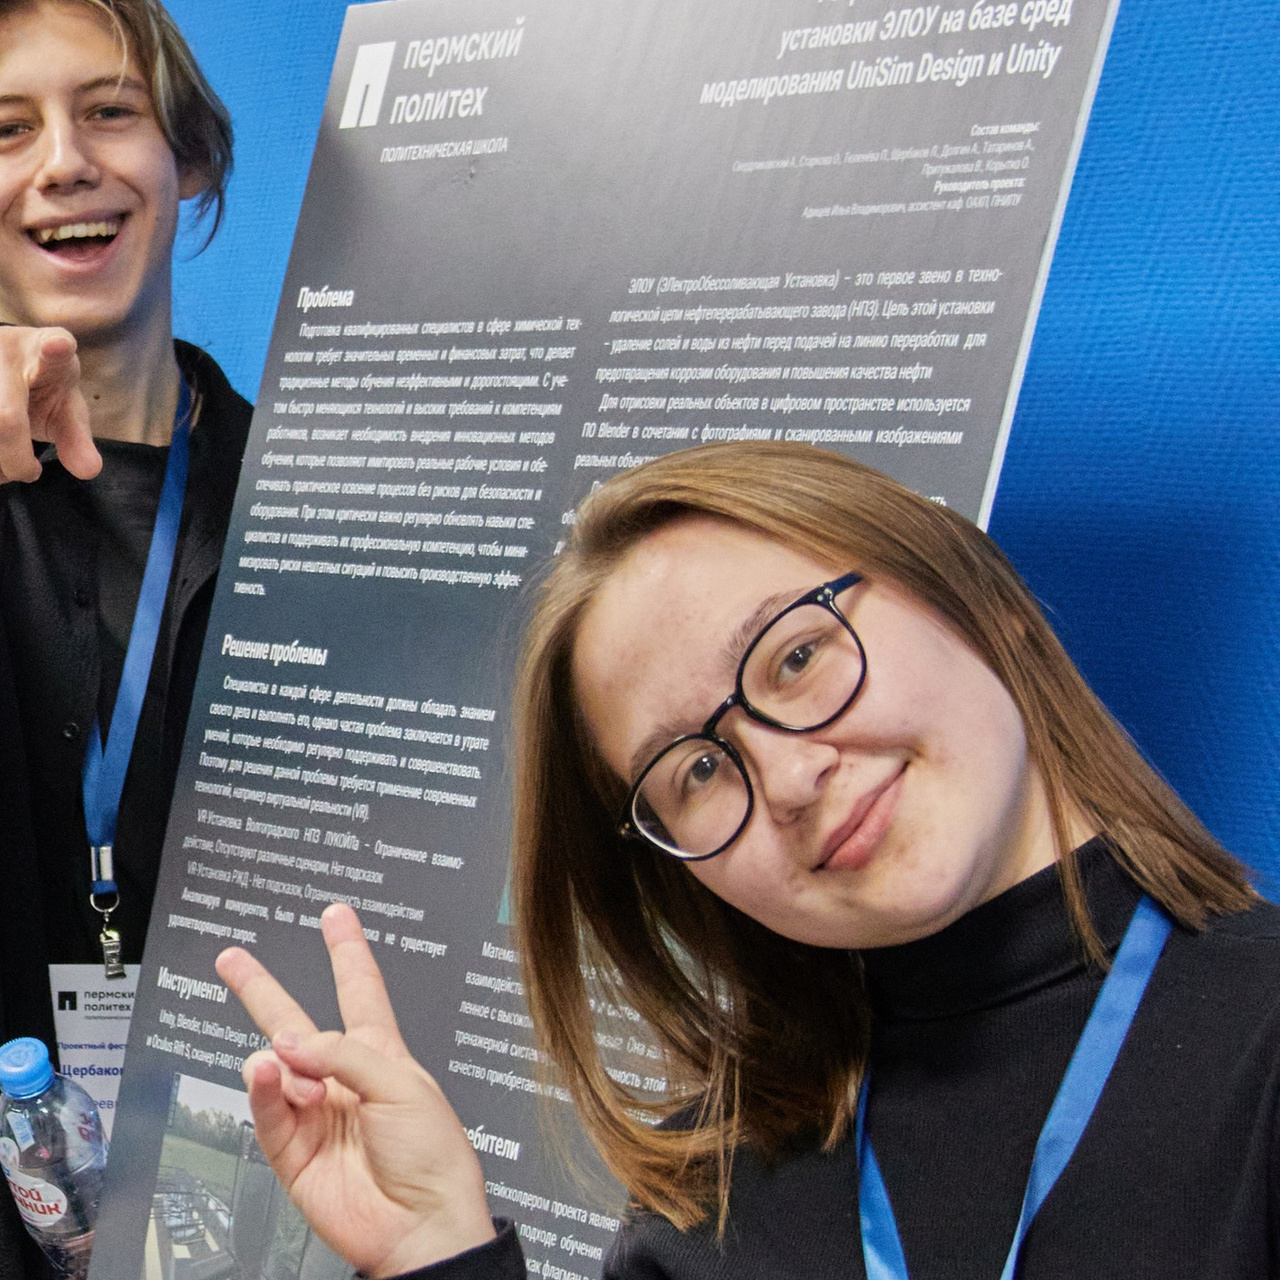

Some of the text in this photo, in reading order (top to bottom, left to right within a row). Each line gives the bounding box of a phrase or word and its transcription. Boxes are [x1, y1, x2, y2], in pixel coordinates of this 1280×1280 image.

[776, 20, 878, 59] установки
[879, 4, 940, 40] ЭЛОУ
[938, 8, 965, 34] на
[403, 16, 524, 78] пермский
[699, 39, 1062, 107] моделирования UniSim Design и Unity
[389, 86, 488, 124] политех
[379, 137, 508, 163] ПОЛИТЕХНИЧЕСКАЯ ШКОЛА
[628, 277, 656, 294] ЭЛОУ
[656, 274, 781, 296] (ЭЛектроОбессоливающая
[783, 269, 840, 290] Установка)
[854, 272, 874, 286] это
[876, 271, 916, 289] первое
[918, 270, 952, 284] звено
[968, 268, 1003, 282] техно-
[296, 284, 355, 313] Проблема
[608, 306, 661, 323] логической
[659, 308, 684, 324] цепи
[683, 303, 810, 324] нефтеперерабатывающего
[810, 304, 847, 320] завода
[881, 299, 909, 319] Цель
[910, 298, 937, 316] этой
[935, 300, 996, 319] установки
[609, 338, 653, 355] удаление
[653, 334, 682, 351] солей
[690, 337, 717, 353] воды
[716, 337, 731, 350] из
[730, 333, 762, 353] нефти
[762, 336, 793, 352] перед
[793, 332, 837, 351] подачей
[837, 335, 852, 348] на
[852, 334, 889, 348] линию
[889, 329, 960, 351] переработки
[962, 333, 987, 350] для
[594, 367, 670, 384] предотвращения
[669, 367, 714, 383] коррозии
[713, 363, 782, 383] оборудования
[789, 366, 850, 380] повышения
[849, 365, 898, 380] качества
[898, 361, 933, 383] нефти
[597, 393, 619, 412] Для
[619, 396, 667, 413] отрисовки
[666, 396, 714, 413] реальных
[713, 393, 760, 410] объектов
[769, 393, 823, 414] цифровом
[823, 397, 895, 415] пространстве
[895, 397, 972, 416] используется
[581, 421, 597, 438] ПО
[597, 421, 631, 438] Blender
[641, 426, 690, 439] сочетании
[700, 423, 772, 443] фотографиями
[784, 428, 874, 445] сканированными
[875, 425, 964, 447] изображениями
[573, 454, 618, 470] реальных
[221, 633, 328, 667] Решение проблемы
[222, 674, 269, 694] Специалисты
[278, 684, 307, 700] каждой
[308, 685, 332, 704] сфере
[332, 691, 385, 708] деятельности
[385, 697, 419, 712] должны
[420, 698, 457, 718] обладать
[459, 705, 496, 721] знанием
[84, 990, 135, 1001] пермски
[157, 967, 227, 1004] Инструменты
[454, 1029, 509, 1054] тренажерной
[485, 1180, 550, 1211] стейкхолдером
[550, 1200, 588, 1223] проекта
[519, 1223, 603, 1261] подходе обучения
